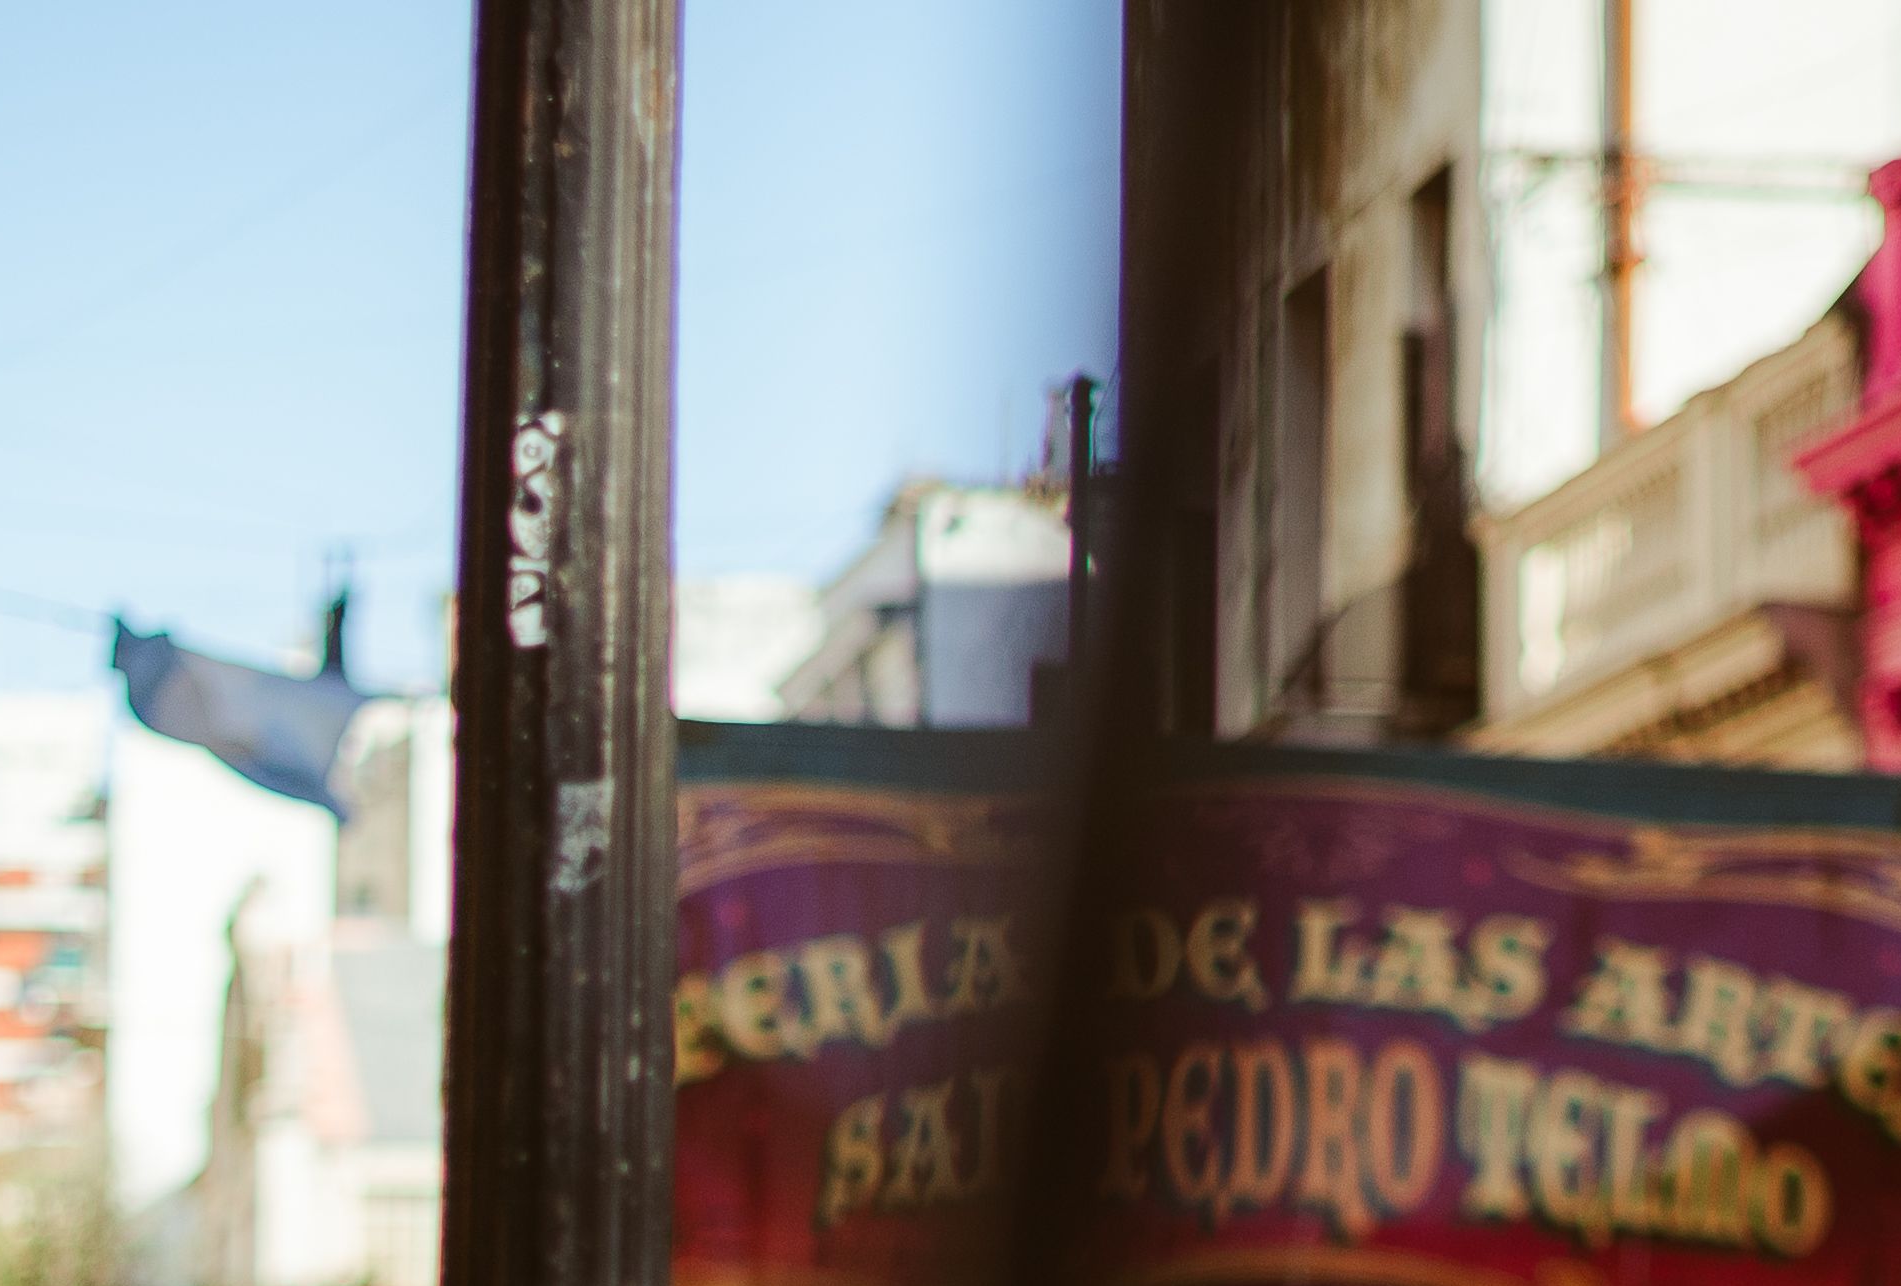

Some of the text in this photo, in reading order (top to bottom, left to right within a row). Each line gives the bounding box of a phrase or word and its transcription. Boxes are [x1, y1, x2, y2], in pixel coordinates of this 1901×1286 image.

[1104, 900, 1271, 1015] DE
[1289, 900, 1554, 1033] LAS
[1102, 1040, 1446, 1237] PEDRO
[1457, 1050, 1834, 1257] TELMO
